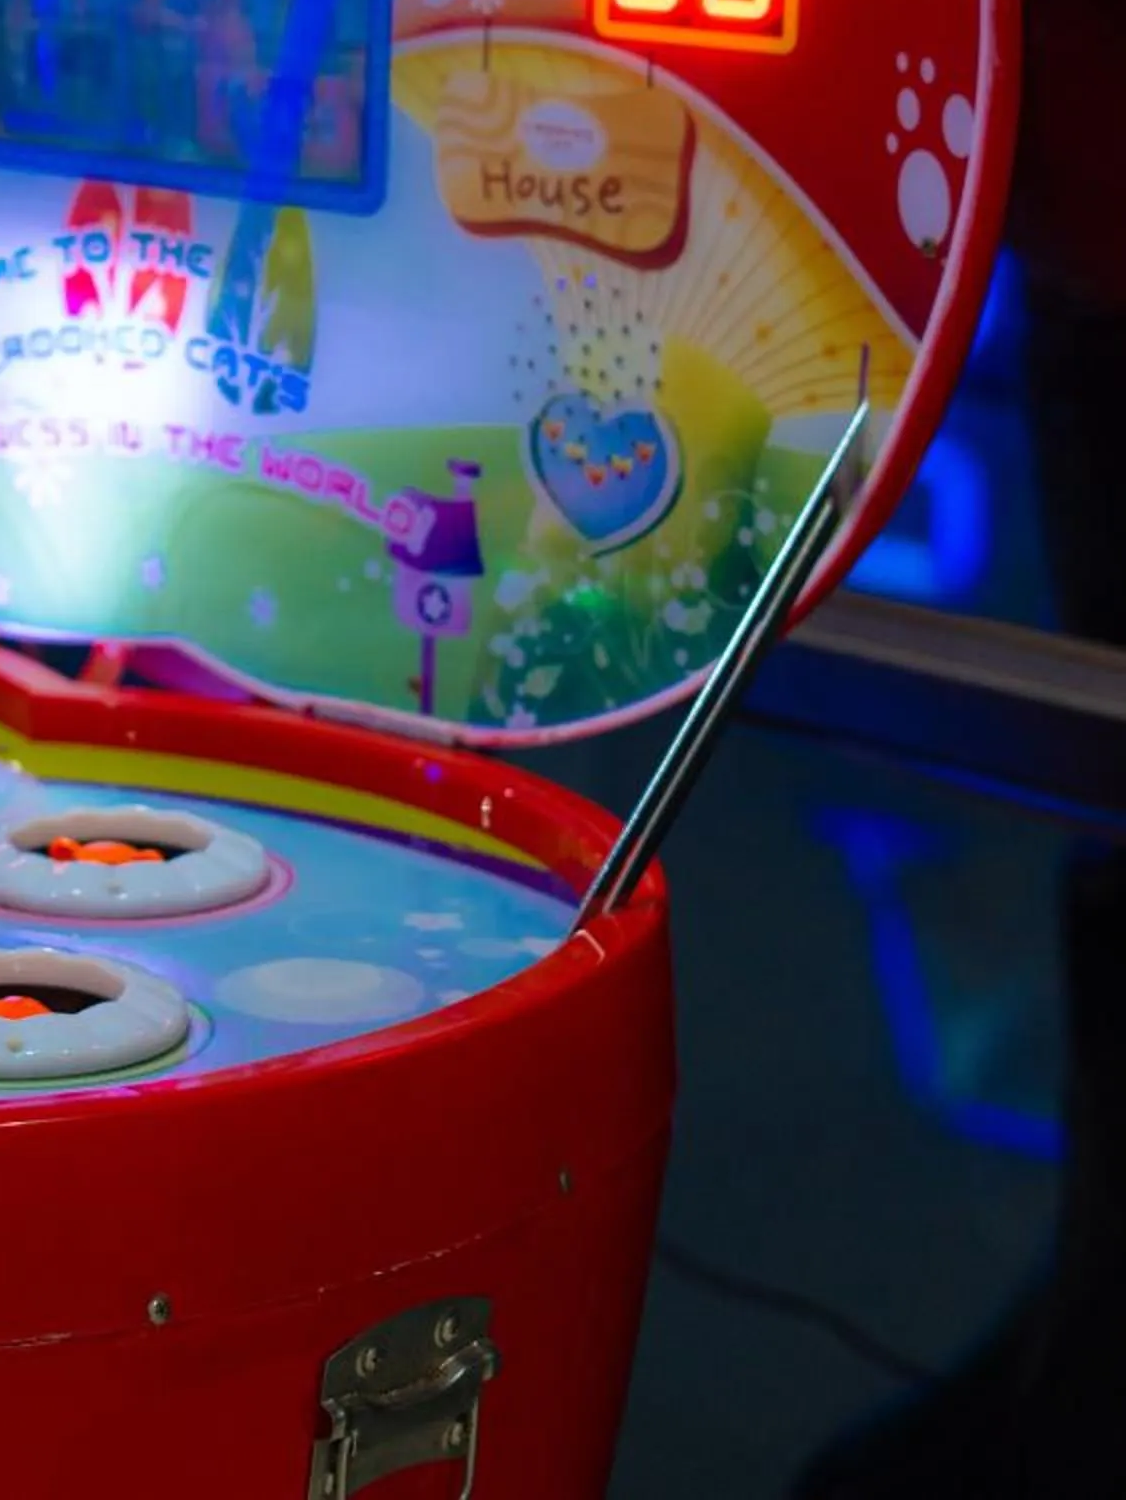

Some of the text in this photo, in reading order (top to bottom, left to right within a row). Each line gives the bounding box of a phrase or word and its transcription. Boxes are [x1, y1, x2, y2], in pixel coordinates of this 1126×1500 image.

[479, 160, 625, 216] House
[53, 232, 111, 264] TO
[130, 232, 214, 279] THE
[165, 422, 244, 470] THE
